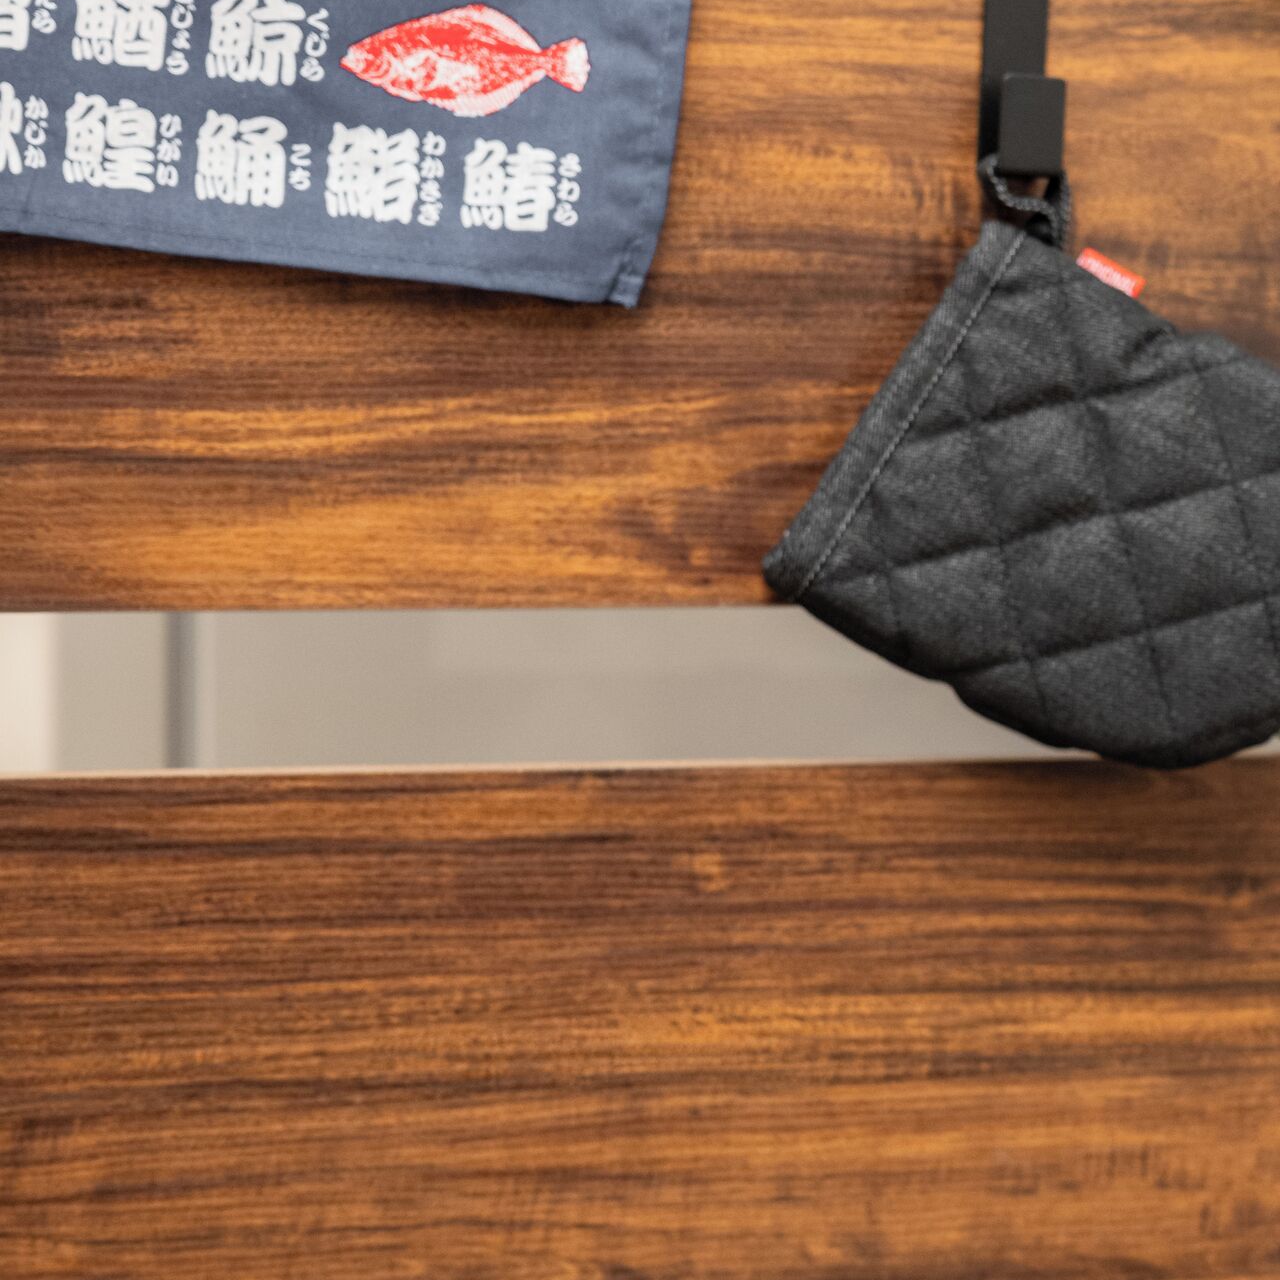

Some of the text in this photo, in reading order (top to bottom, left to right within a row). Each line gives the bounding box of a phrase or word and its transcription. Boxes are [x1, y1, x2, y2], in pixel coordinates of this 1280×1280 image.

[299, 8, 330, 82] くじら
[23, 95, 49, 169] かじか
[155, 113, 183, 188] ひがい
[194, 109, 288, 209] 鯒
[288, 143, 312, 192] こち
[416, 130, 448, 227] わかさぎ
[459, 137, 557, 232] 鰆
[553, 152, 582, 227] さわら
